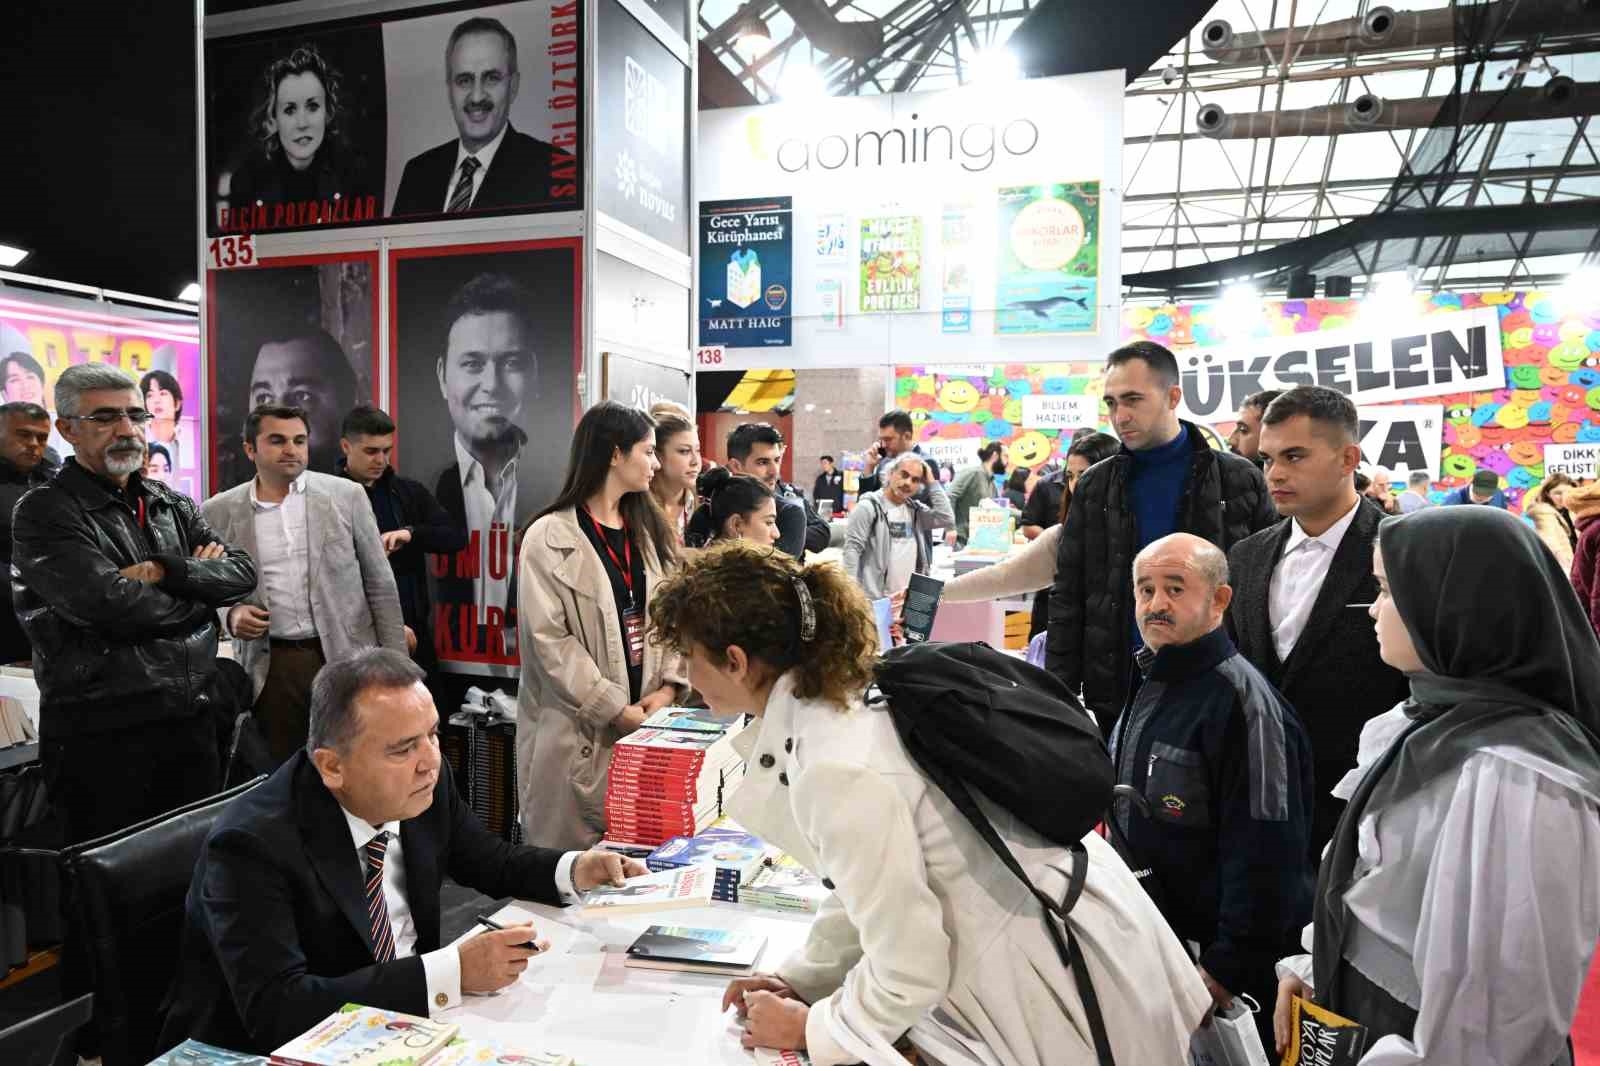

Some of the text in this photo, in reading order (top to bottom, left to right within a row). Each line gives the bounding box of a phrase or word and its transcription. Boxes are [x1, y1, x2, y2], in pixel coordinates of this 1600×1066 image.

[711, 214, 779, 228] Gece Yarısı
[707, 227, 784, 245] Kütüphanesi
[209, 238, 253, 267] 135
[708, 317, 781, 330] MATT HAIG
[697, 350, 722, 364] 138
[1182, 325, 1488, 416] ÜKSELEN
